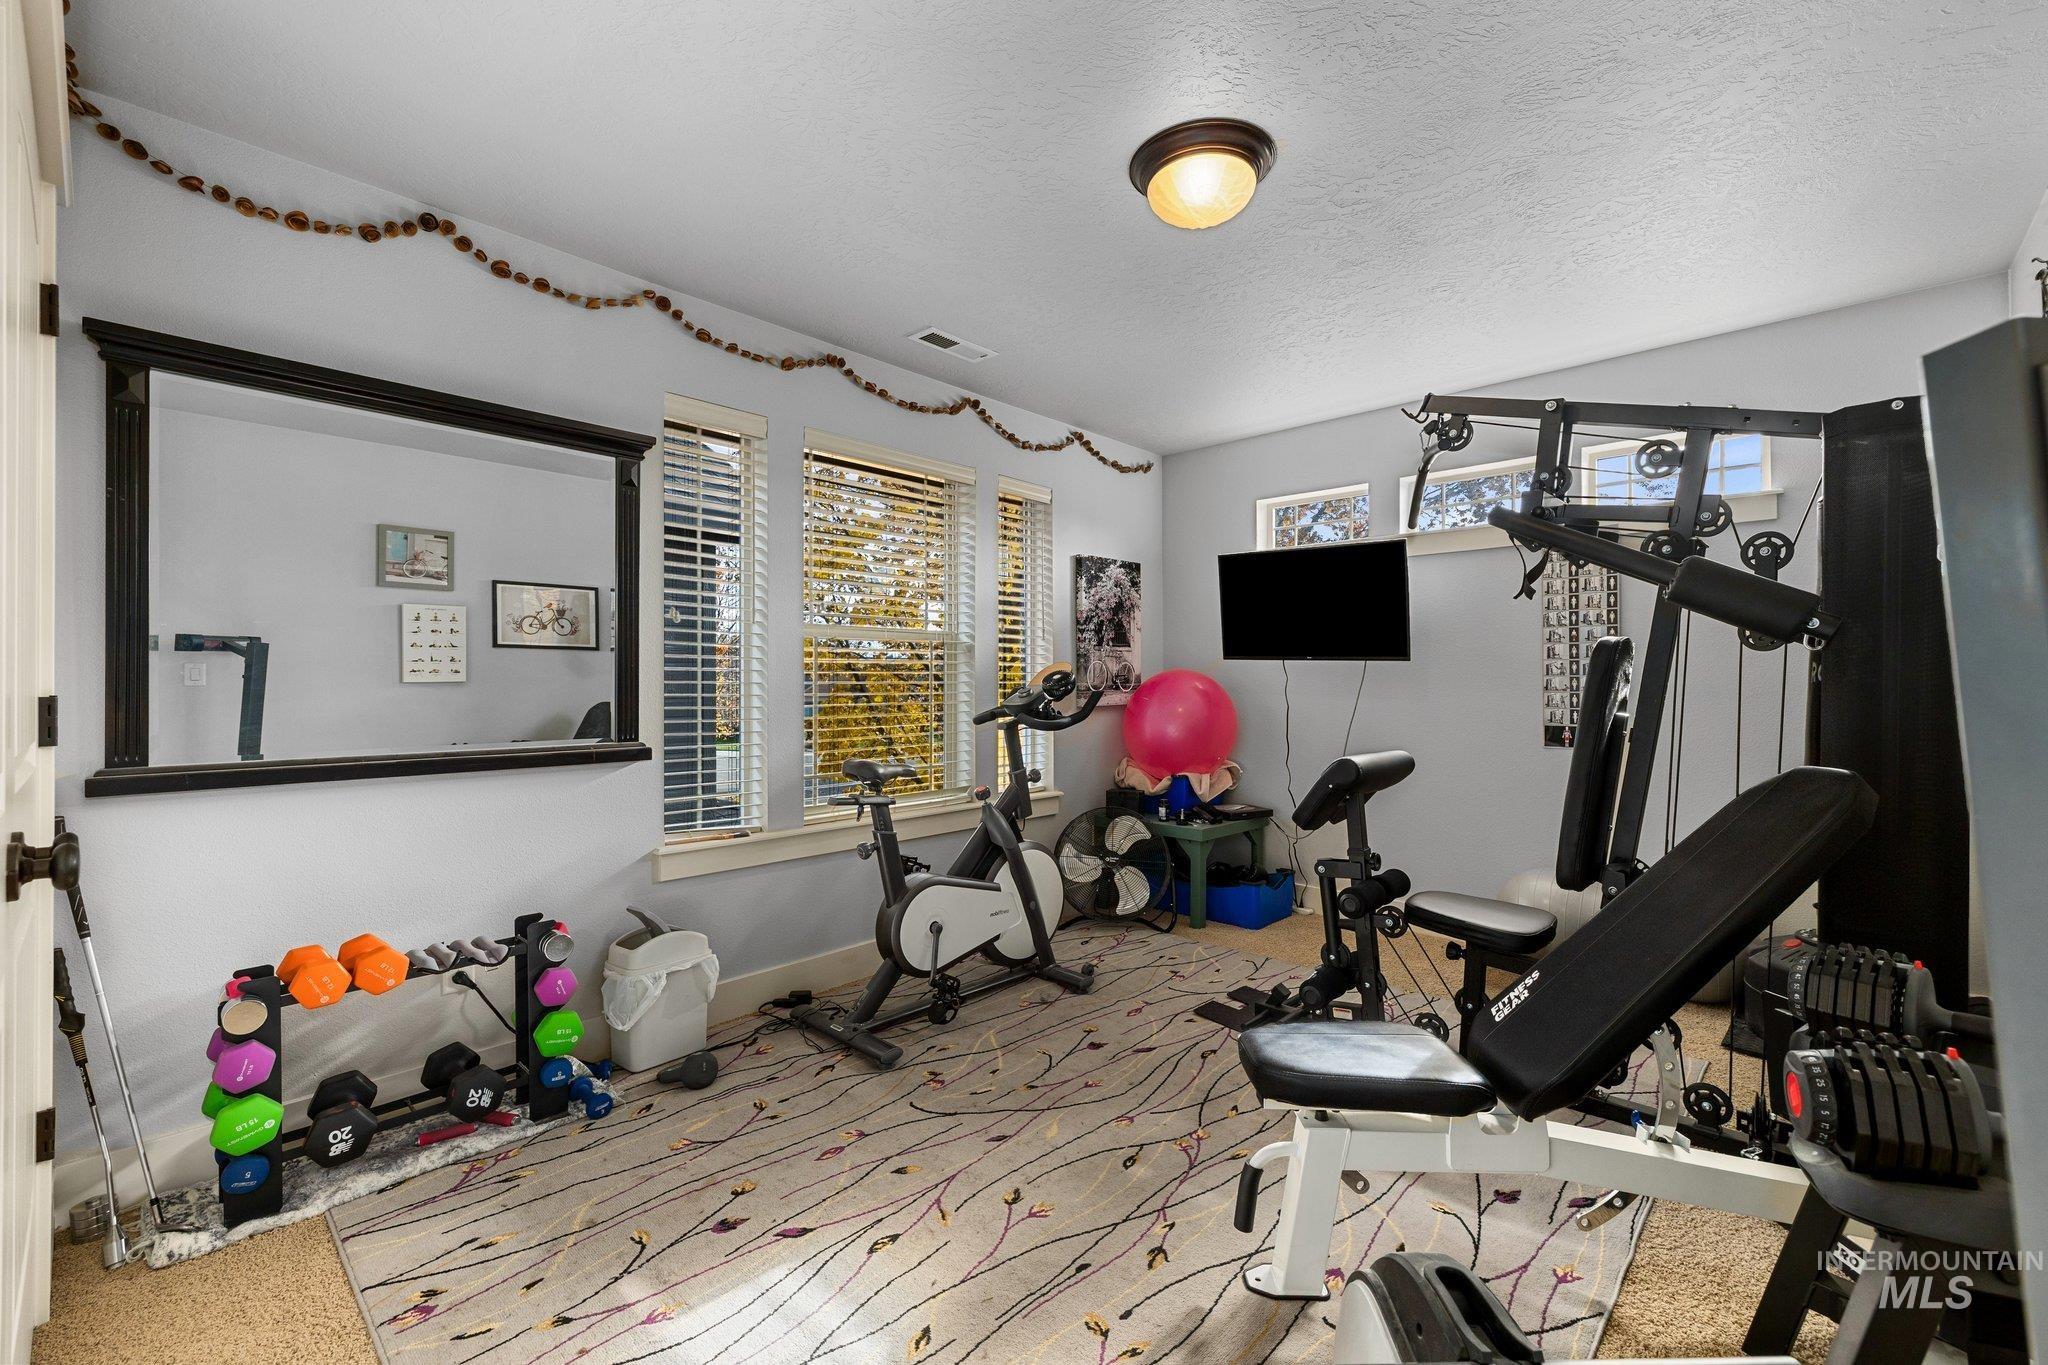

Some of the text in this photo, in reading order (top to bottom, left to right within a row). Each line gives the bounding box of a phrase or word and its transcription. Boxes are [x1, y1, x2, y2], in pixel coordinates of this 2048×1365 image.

[1490, 970, 1540, 1016] FITNESS
[1494, 989, 1530, 1022] GEAR
[1815, 1078, 1826, 1088] 25
[466, 1088, 482, 1108] 20
[1819, 1094, 1830, 1102] 15
[328, 1125, 352, 1144] 20
